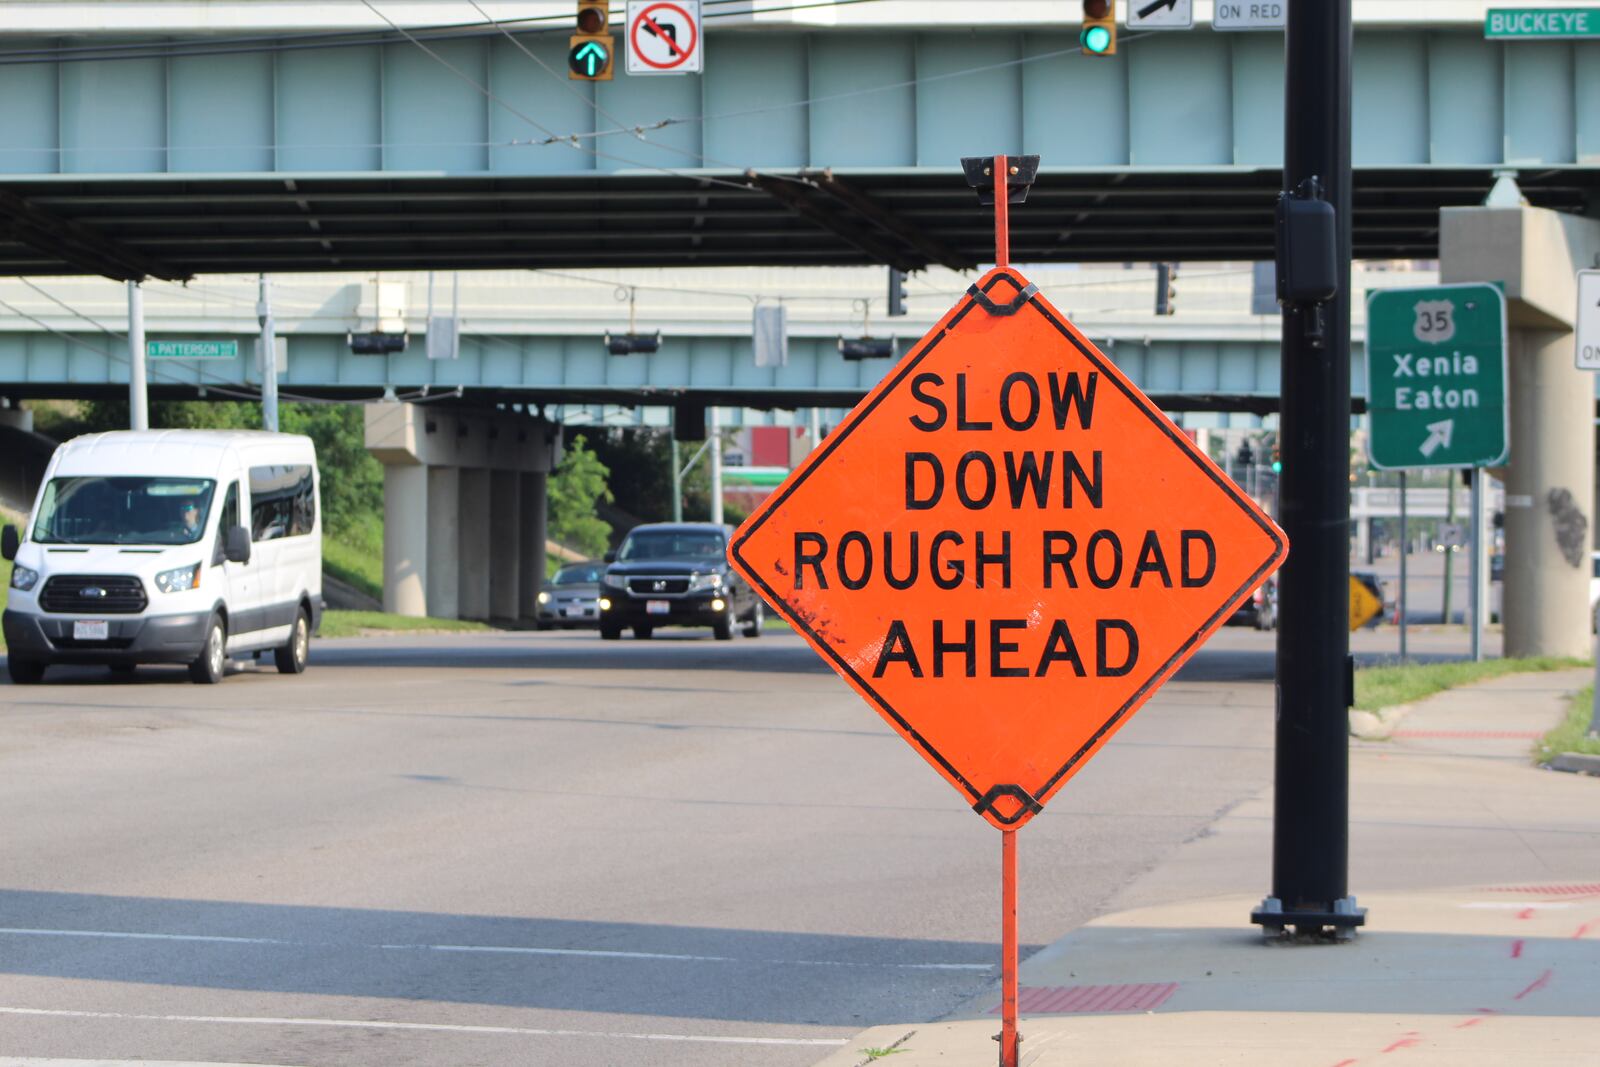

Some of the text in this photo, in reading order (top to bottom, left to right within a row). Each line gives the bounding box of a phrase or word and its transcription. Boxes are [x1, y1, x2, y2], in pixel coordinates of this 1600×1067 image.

[1219, 4, 1281, 19] ON RED
[1491, 13, 1589, 32] BUCKEYE
[1421, 311, 1448, 332] 35
[158, 343, 218, 354] PATTERSON
[1393, 351, 1479, 378] Xenia
[909, 371, 1099, 432] SLOW
[1395, 385, 1479, 410] Eaton
[905, 450, 1103, 510] DOWN
[793, 530, 1217, 590] ROUGH ROAD
[873, 619, 1139, 678] AHEAD
